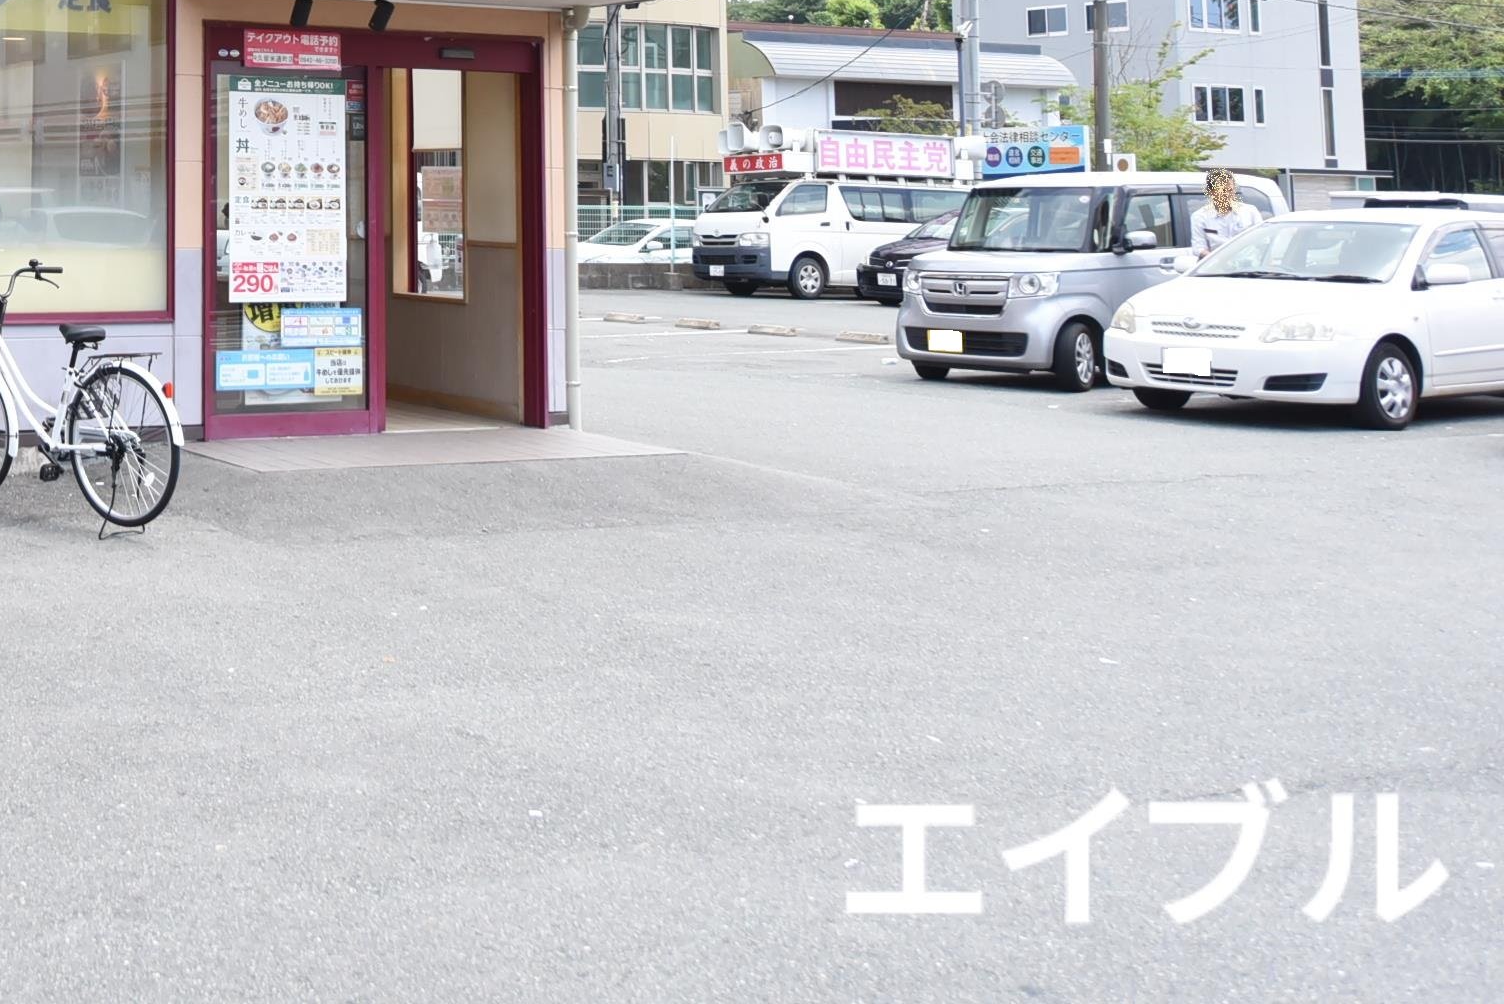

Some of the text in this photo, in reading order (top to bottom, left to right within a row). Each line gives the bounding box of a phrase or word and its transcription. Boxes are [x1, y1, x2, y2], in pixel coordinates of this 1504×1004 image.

[247, 32, 339, 47] テイクアウト電話予約
[238, 97, 249, 129] 牛めし
[819, 137, 948, 172] 自由民主党
[233, 274, 273, 293] 290
